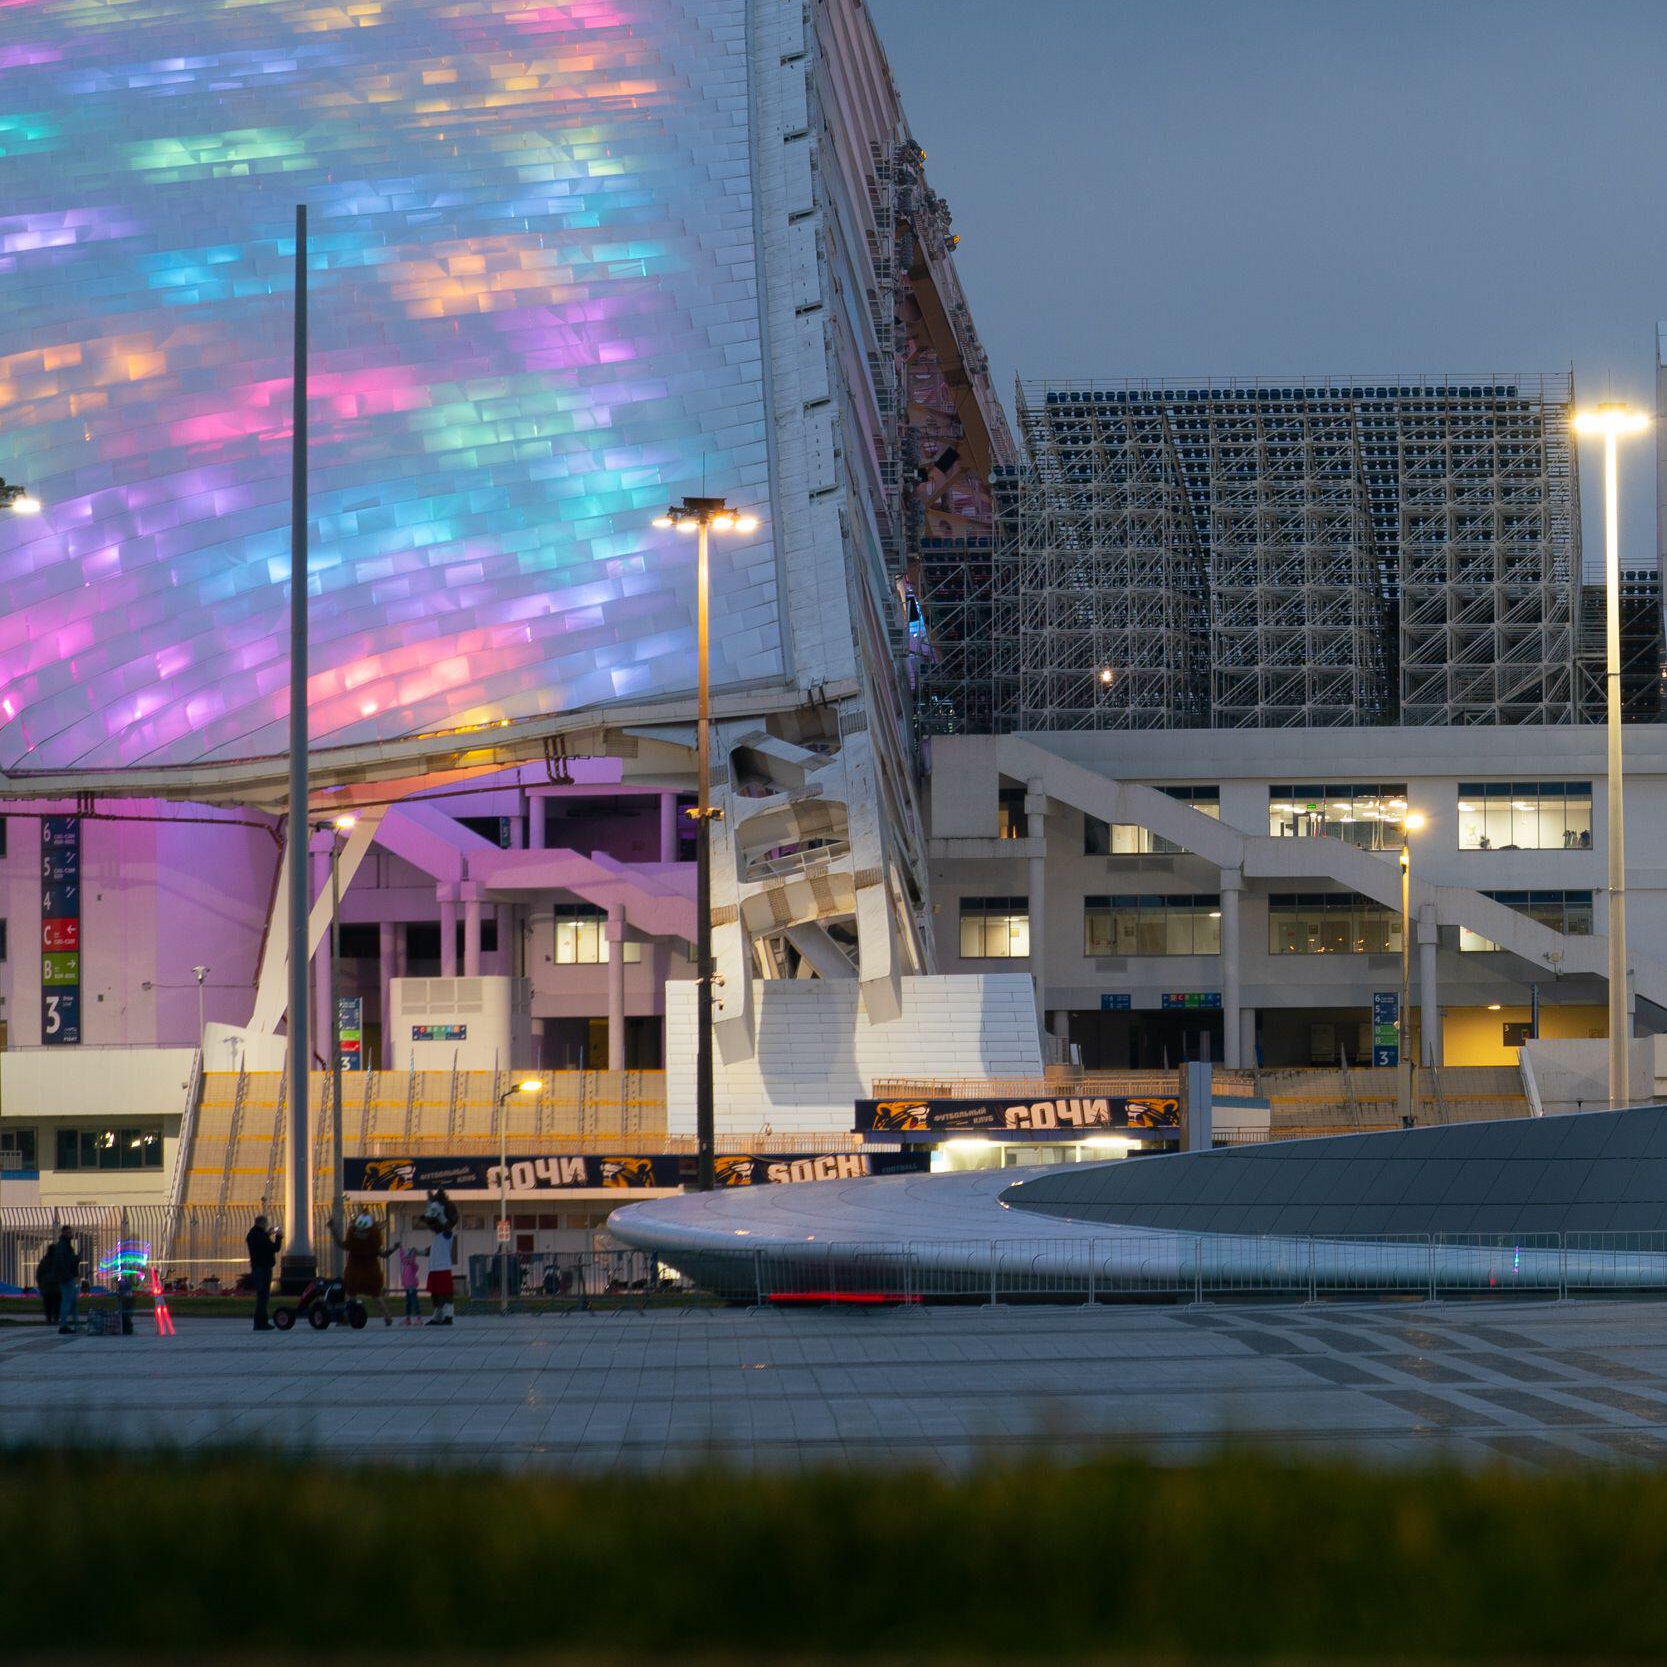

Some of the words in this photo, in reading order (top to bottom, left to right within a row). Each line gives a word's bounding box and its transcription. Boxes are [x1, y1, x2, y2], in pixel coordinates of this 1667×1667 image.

[43, 821, 52, 842] 6
[43, 856, 51, 877] 5
[43, 890, 52, 911] 4
[43, 924, 52, 945] C
[44, 959, 53, 980] B
[1374, 994, 1381, 1003] 6
[1374, 1004, 1381, 1013] 5
[45, 995, 61, 1034] 3
[340, 1056, 352, 1071] 3
[1379, 1050, 1389, 1066] 3
[932, 1106, 987, 1122] ФУТБОЛЬНЫЙ
[973, 1115, 994, 1124] КЛУБ
[1004, 1099, 1110, 1129] СОЧИ
[486, 1157, 589, 1191] СОЧИ
[766, 1154, 872, 1183] SOCHI
